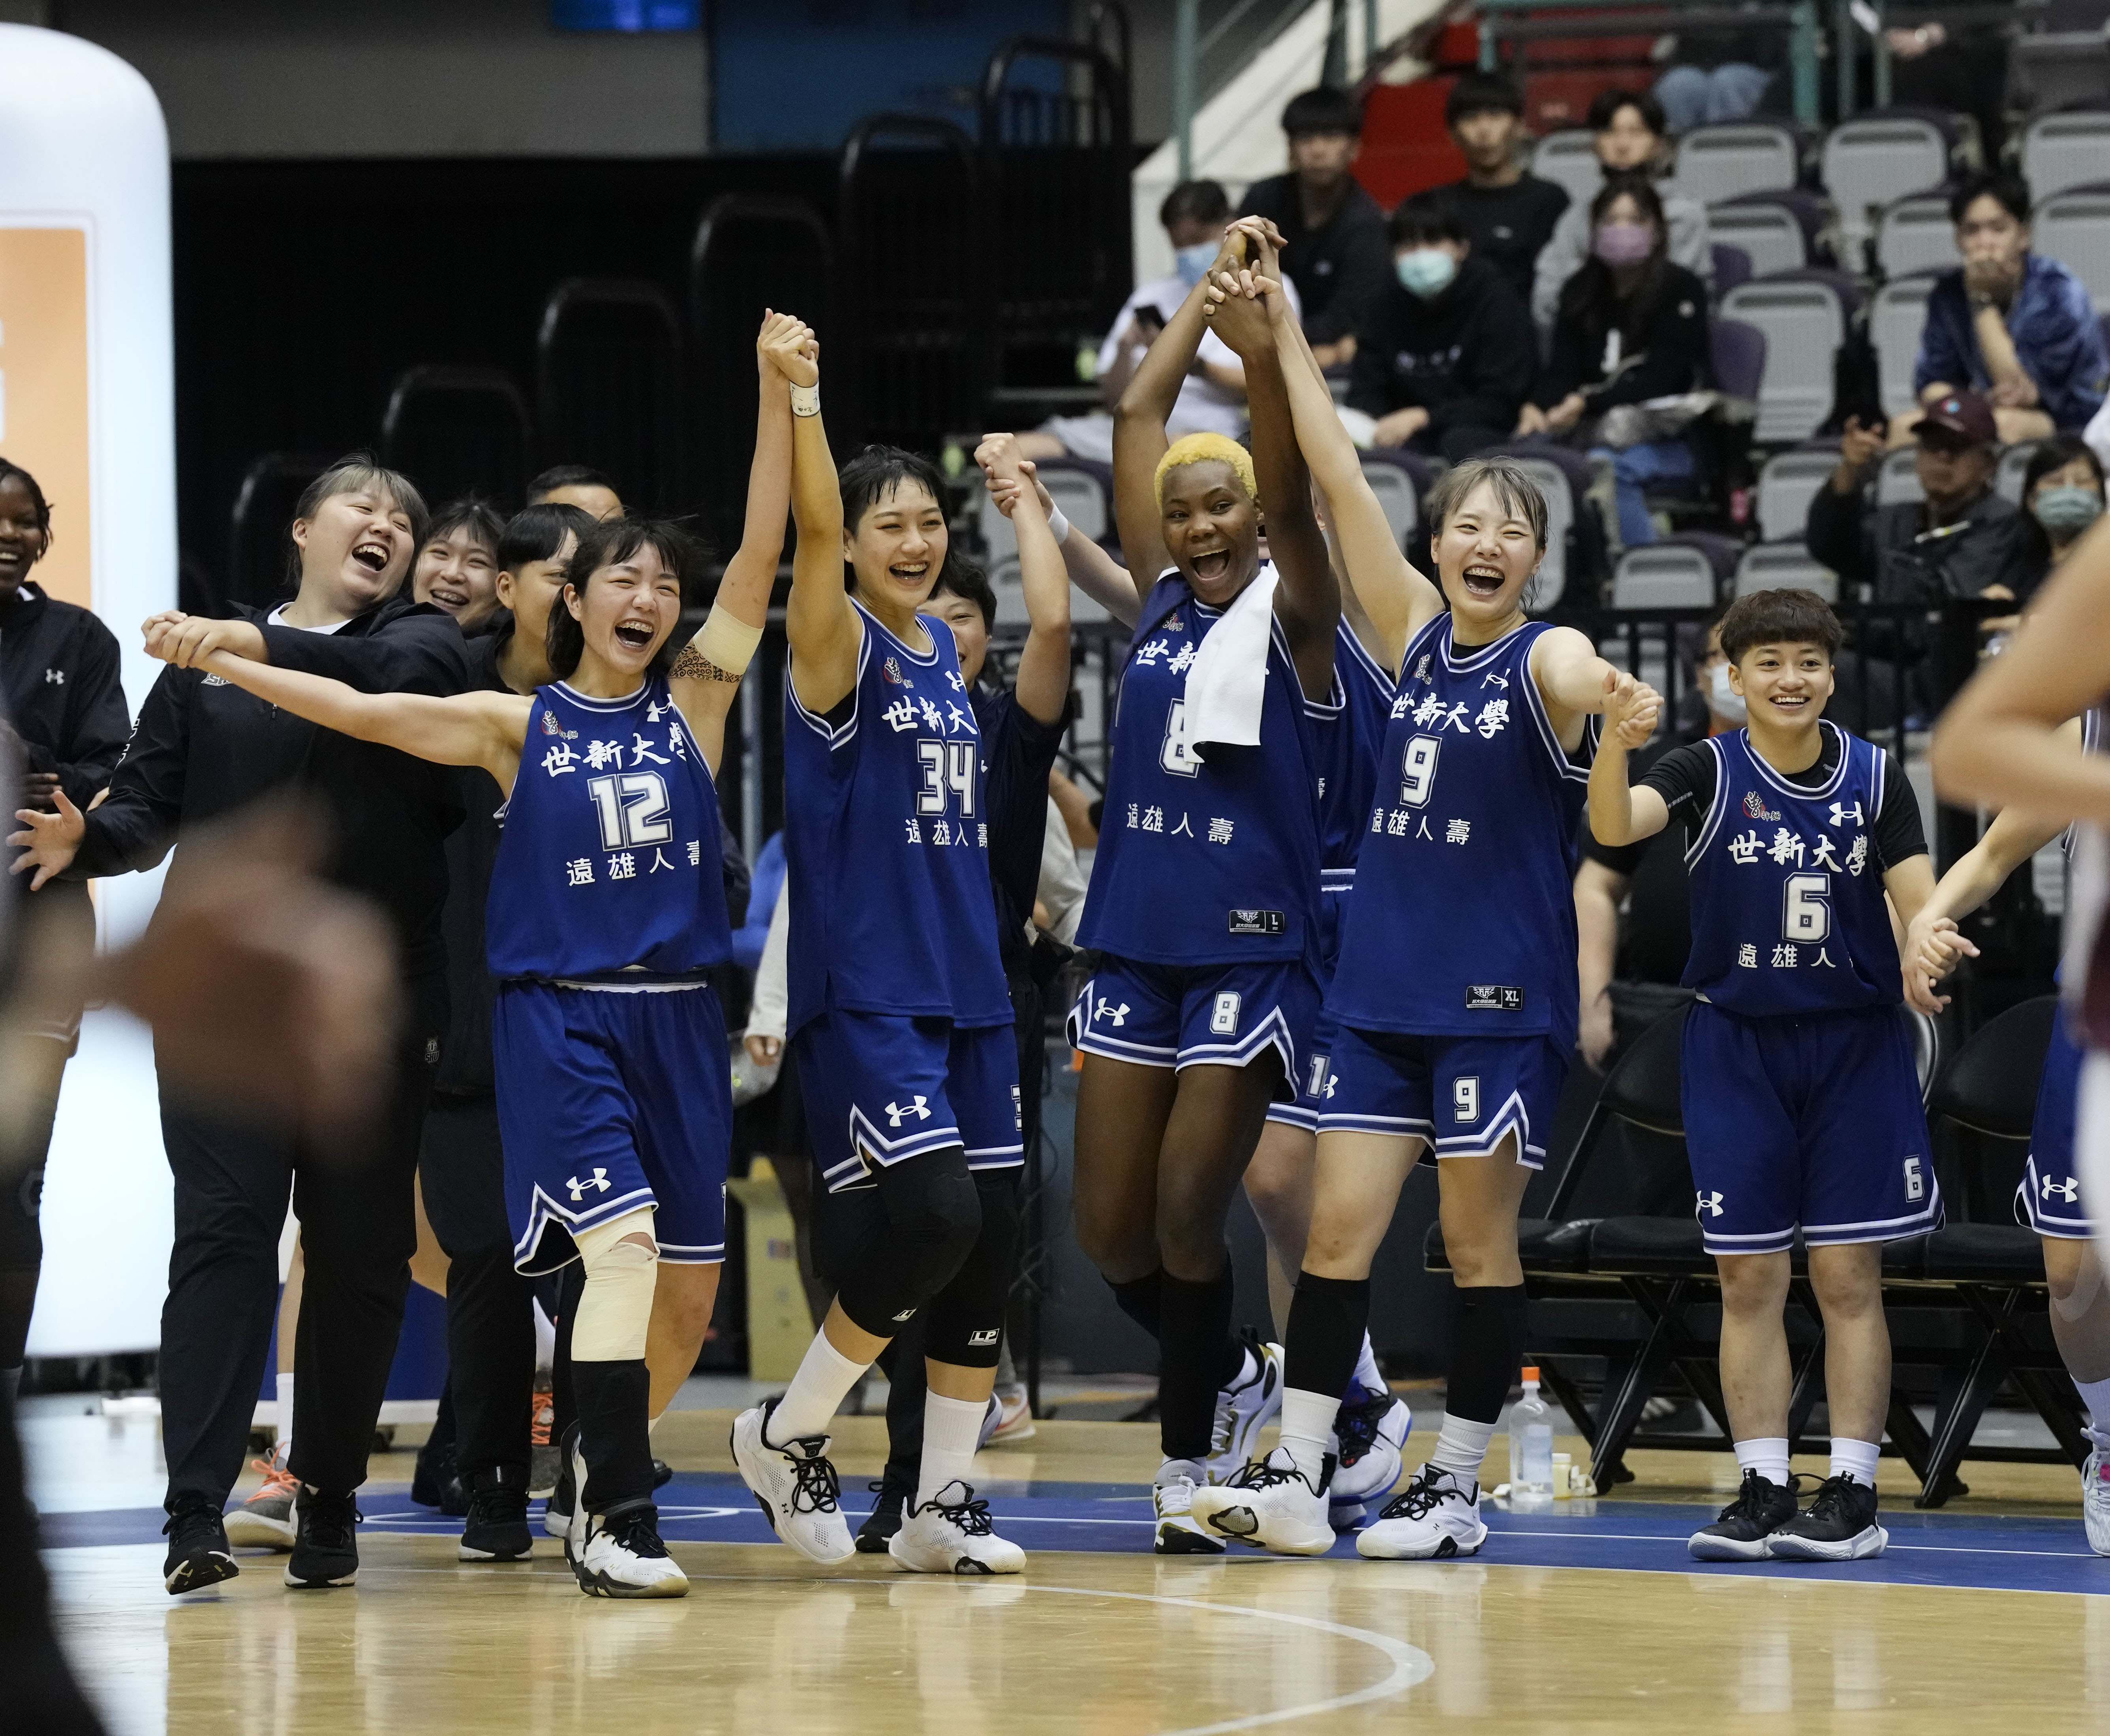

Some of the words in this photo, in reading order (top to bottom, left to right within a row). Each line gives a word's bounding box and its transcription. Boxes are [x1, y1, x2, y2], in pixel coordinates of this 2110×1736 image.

[882, 696, 978, 736] 世新大
[1390, 689, 1509, 739] 世新大學
[917, 739, 976, 818] 34
[1399, 733, 1442, 809] 9
[587, 771, 672, 851] 12
[1127, 803, 1234, 844] 遠雄人壽
[1371, 807, 1470, 845] 遠雄人壽
[1728, 828, 1867, 877] 世新大學
[1272, 914, 1278, 925] L
[1782, 872, 1830, 944] 6
[1738, 942, 1853, 968] 遠雄人
[1210, 991, 1241, 1035] 8
[1505, 990, 1519, 1001] XL
[1453, 1076, 1479, 1123] 9
[1904, 1155, 1924, 1202] 6
[974, 1331, 996, 1340] LP
